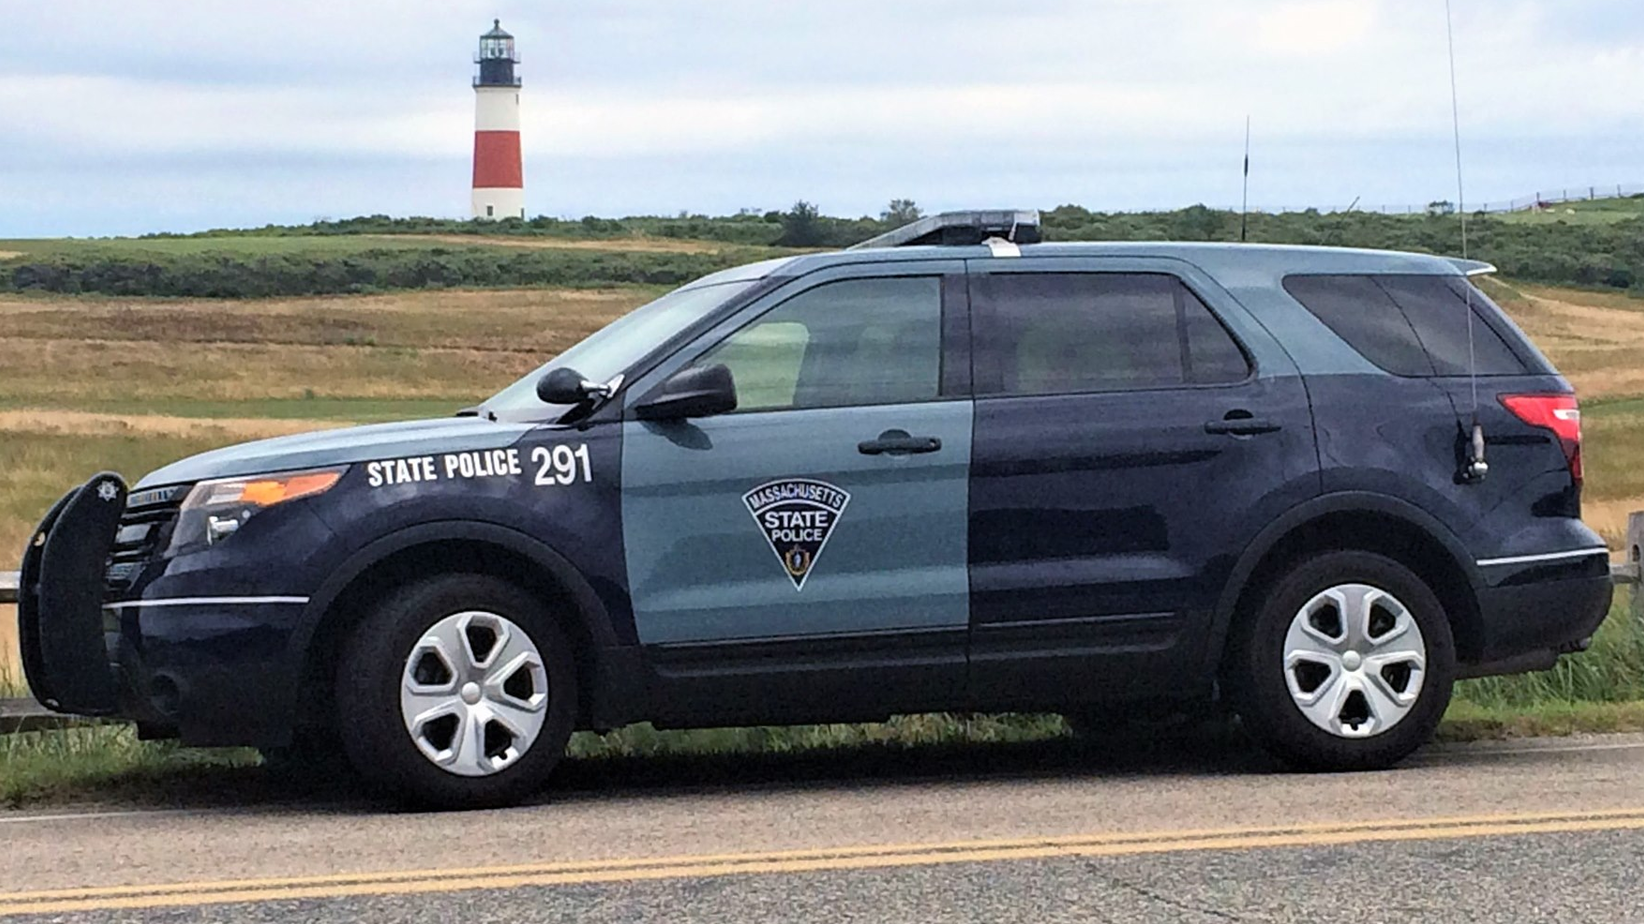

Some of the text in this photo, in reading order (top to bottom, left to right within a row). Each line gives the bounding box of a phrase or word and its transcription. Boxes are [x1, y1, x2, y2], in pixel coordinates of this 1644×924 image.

[368, 443, 593, 487] STATE POLICE 291
[748, 483, 844, 510] MASSACHUSETTS
[764, 511, 829, 529] STATE
[771, 529, 823, 542] POLICE
